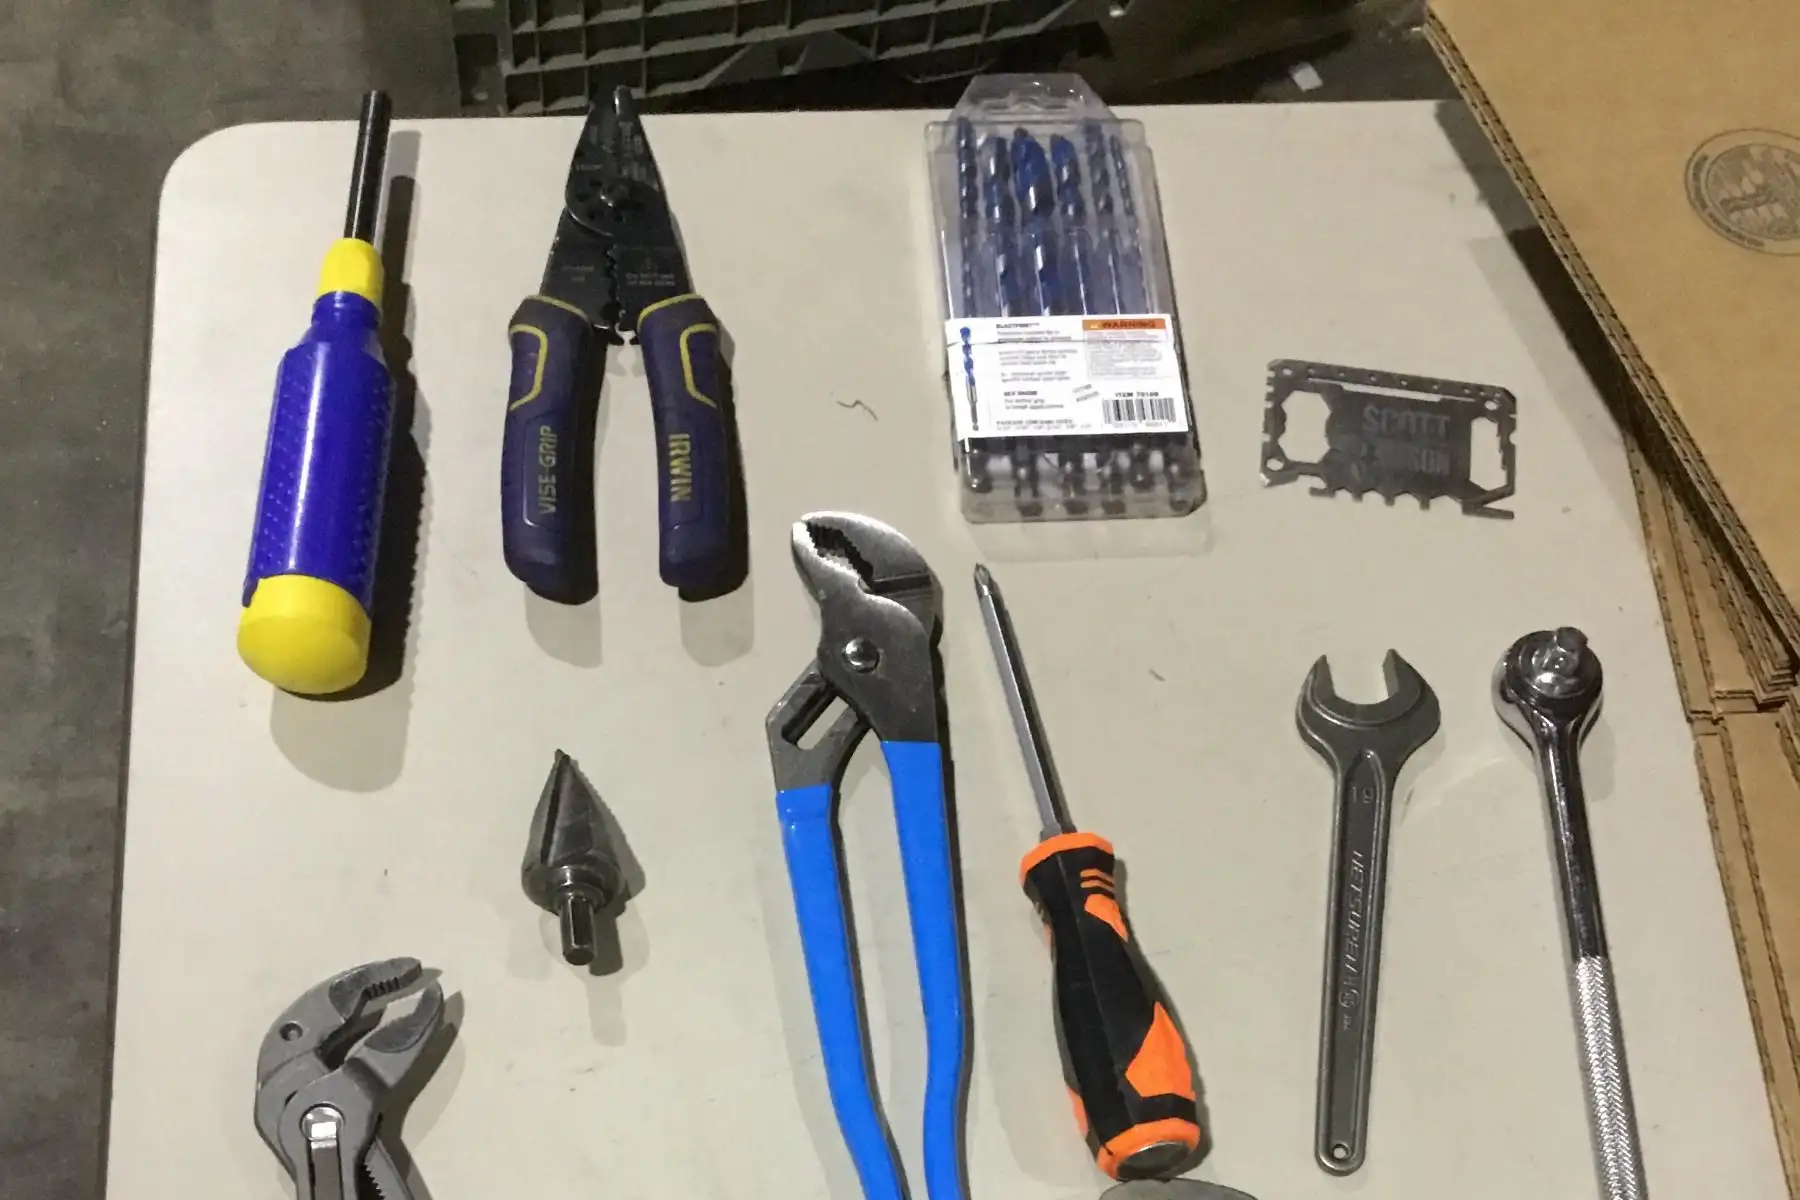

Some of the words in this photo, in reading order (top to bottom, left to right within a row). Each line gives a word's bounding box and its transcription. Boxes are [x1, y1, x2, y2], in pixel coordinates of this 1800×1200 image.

[1101, 319, 1157, 329] WARNING
[1361, 402, 1450, 438] SCOTT
[538, 425, 559, 514] VISE-GRIP
[667, 433, 693, 502] IRWIN
